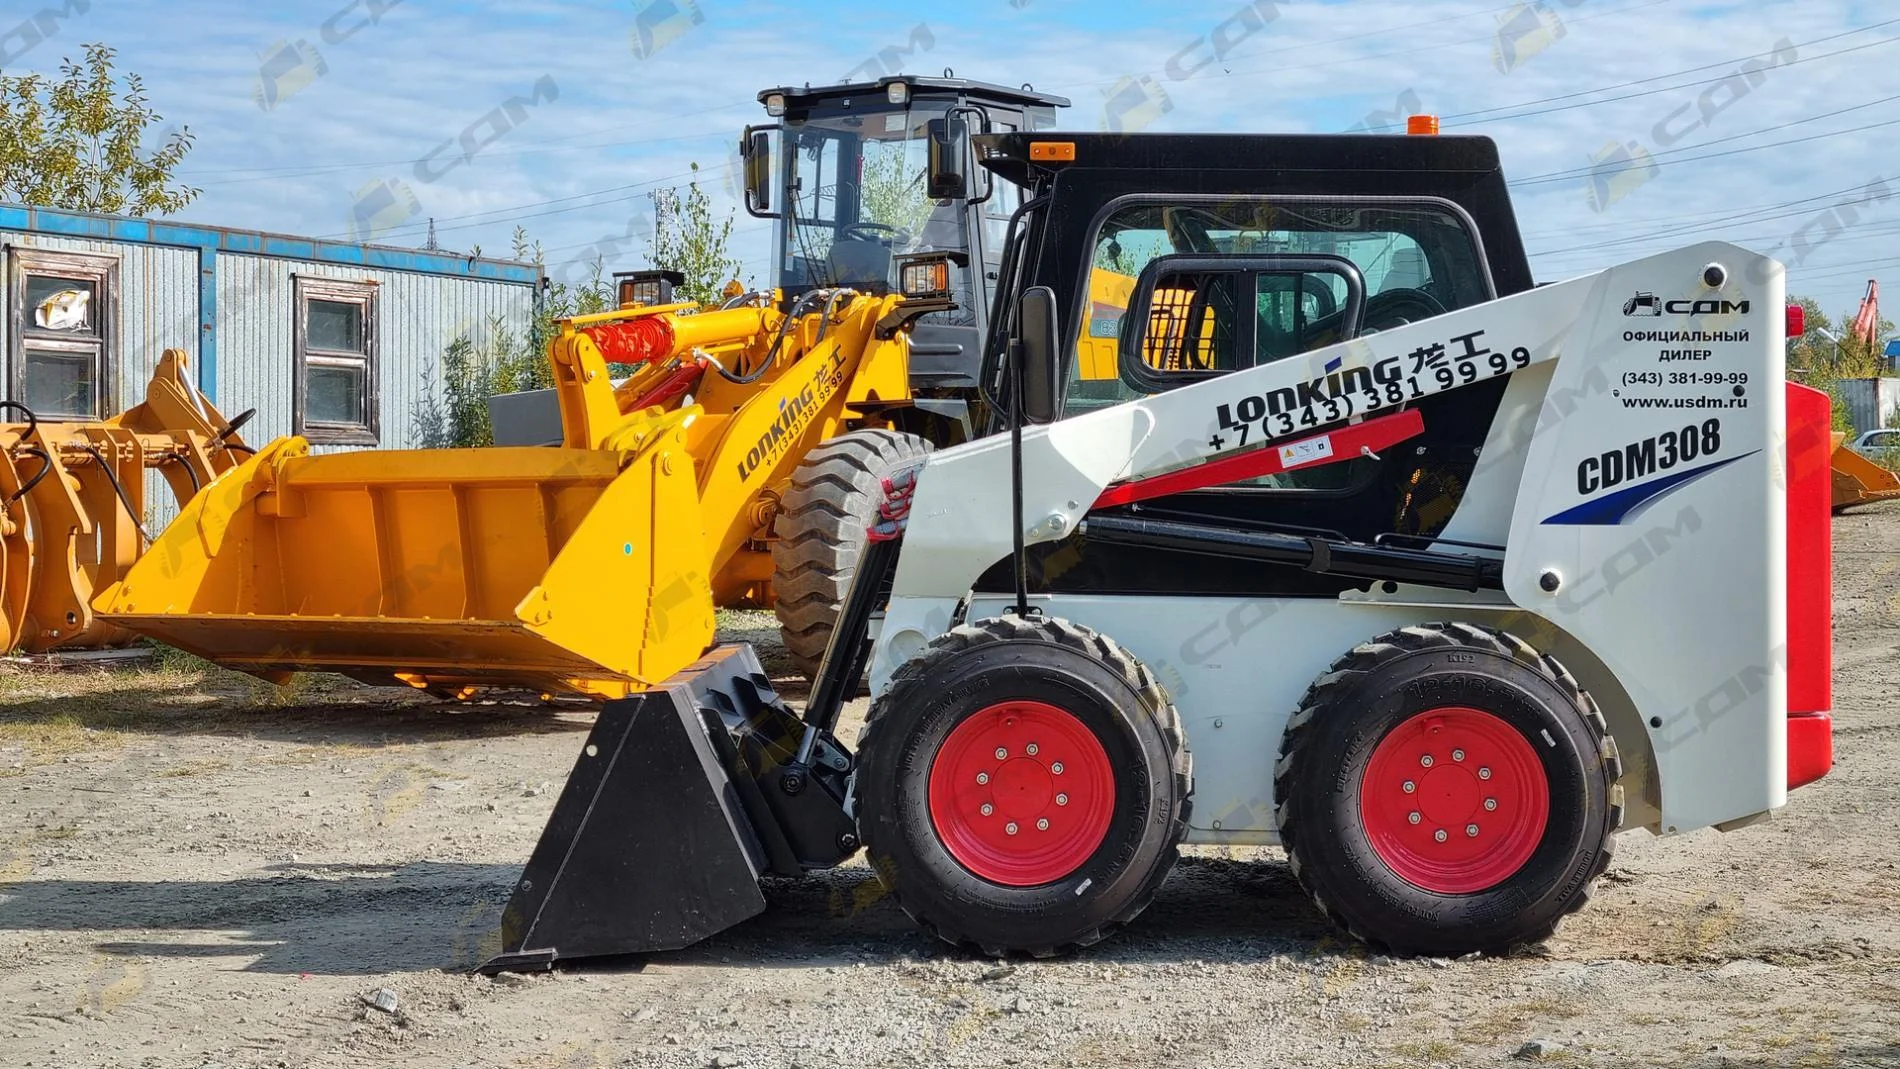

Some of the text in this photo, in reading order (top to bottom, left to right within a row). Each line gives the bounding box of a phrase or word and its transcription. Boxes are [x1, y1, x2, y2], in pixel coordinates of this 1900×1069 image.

[1622, 329, 1749, 343] ОФИЦИАЛЬНЫЙ
[1658, 350, 1712, 362] ДИЛЕР
[1622, 372, 1748, 387] (343) 381-99-99
[1262, 395, 1354, 440] (343)
[1363, 376, 1425, 410] 381
[1622, 396, 1748, 408] www.usdm.ru
[1577, 418, 1721, 495] CDM308
